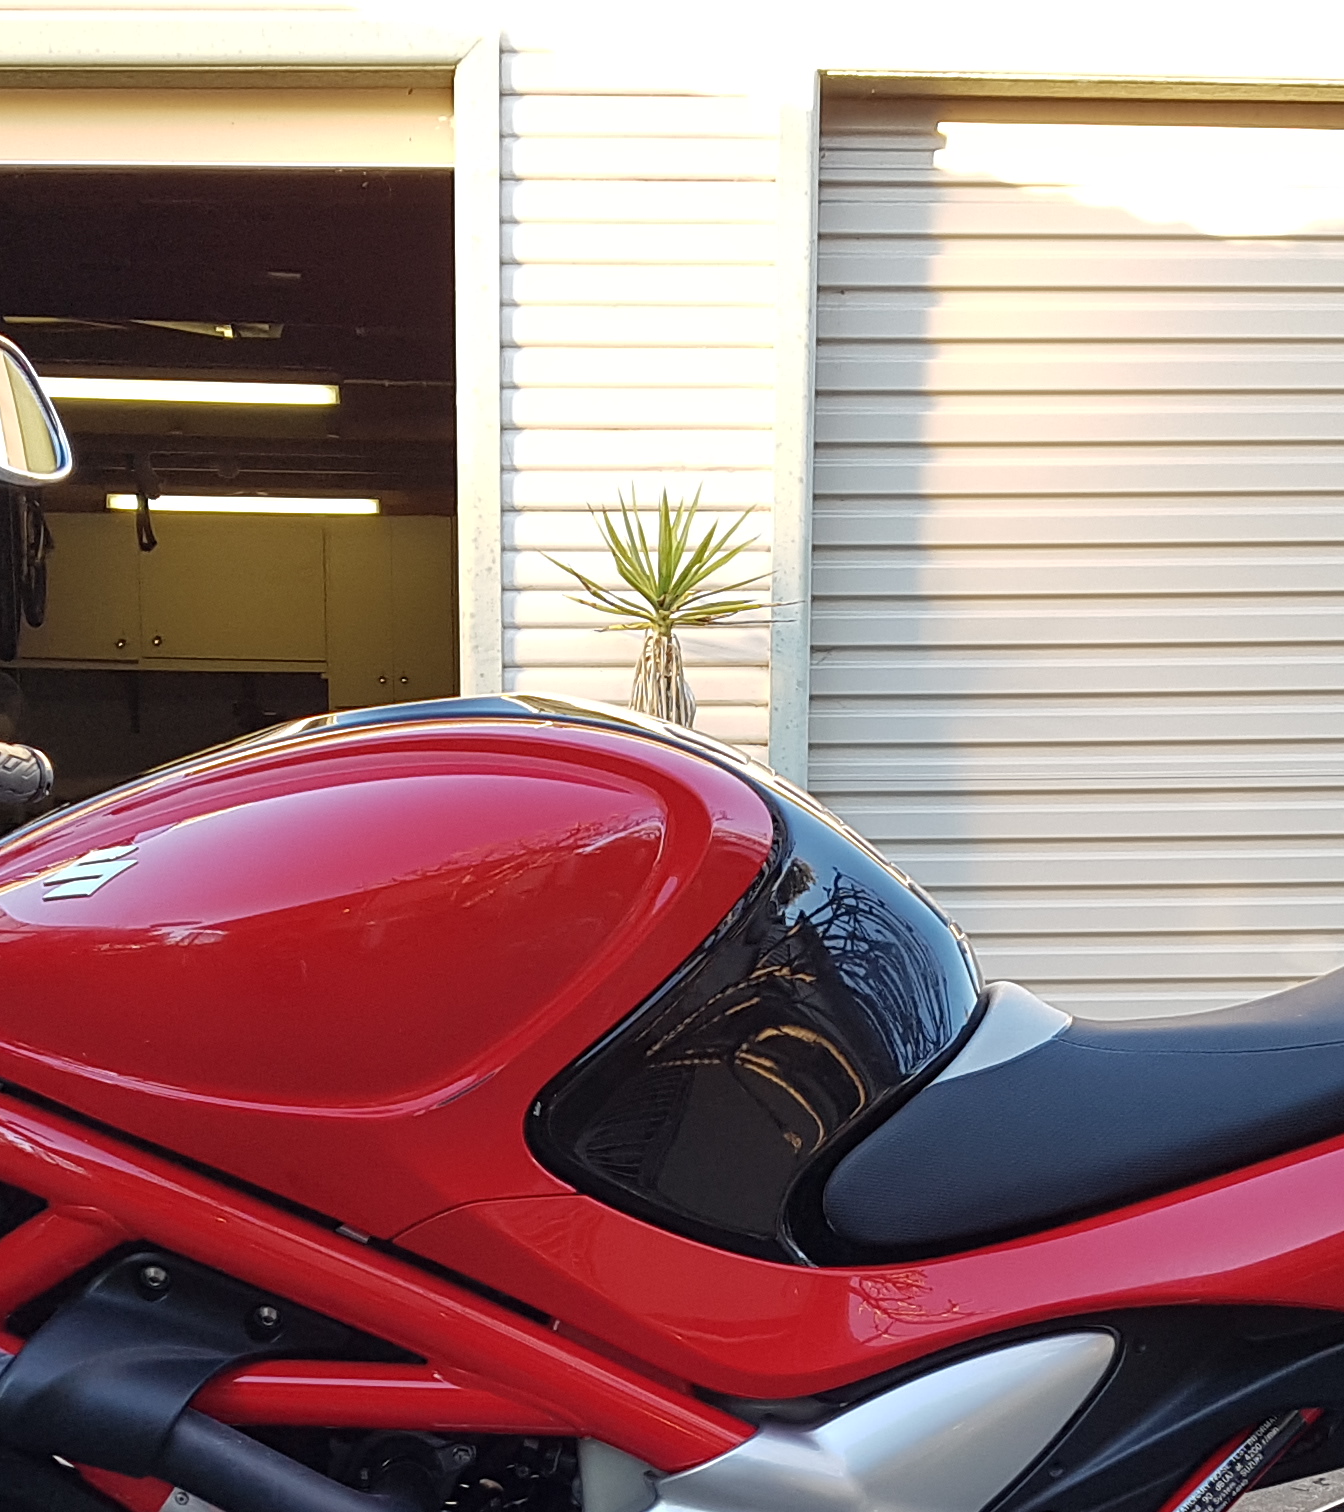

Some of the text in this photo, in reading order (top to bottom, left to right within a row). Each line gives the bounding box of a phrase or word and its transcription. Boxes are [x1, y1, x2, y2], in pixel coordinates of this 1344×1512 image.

[1201, 1492, 1213, 1504] 90
[1234, 1462, 1243, 1471] at
[1243, 1442, 1263, 1462] 4200
